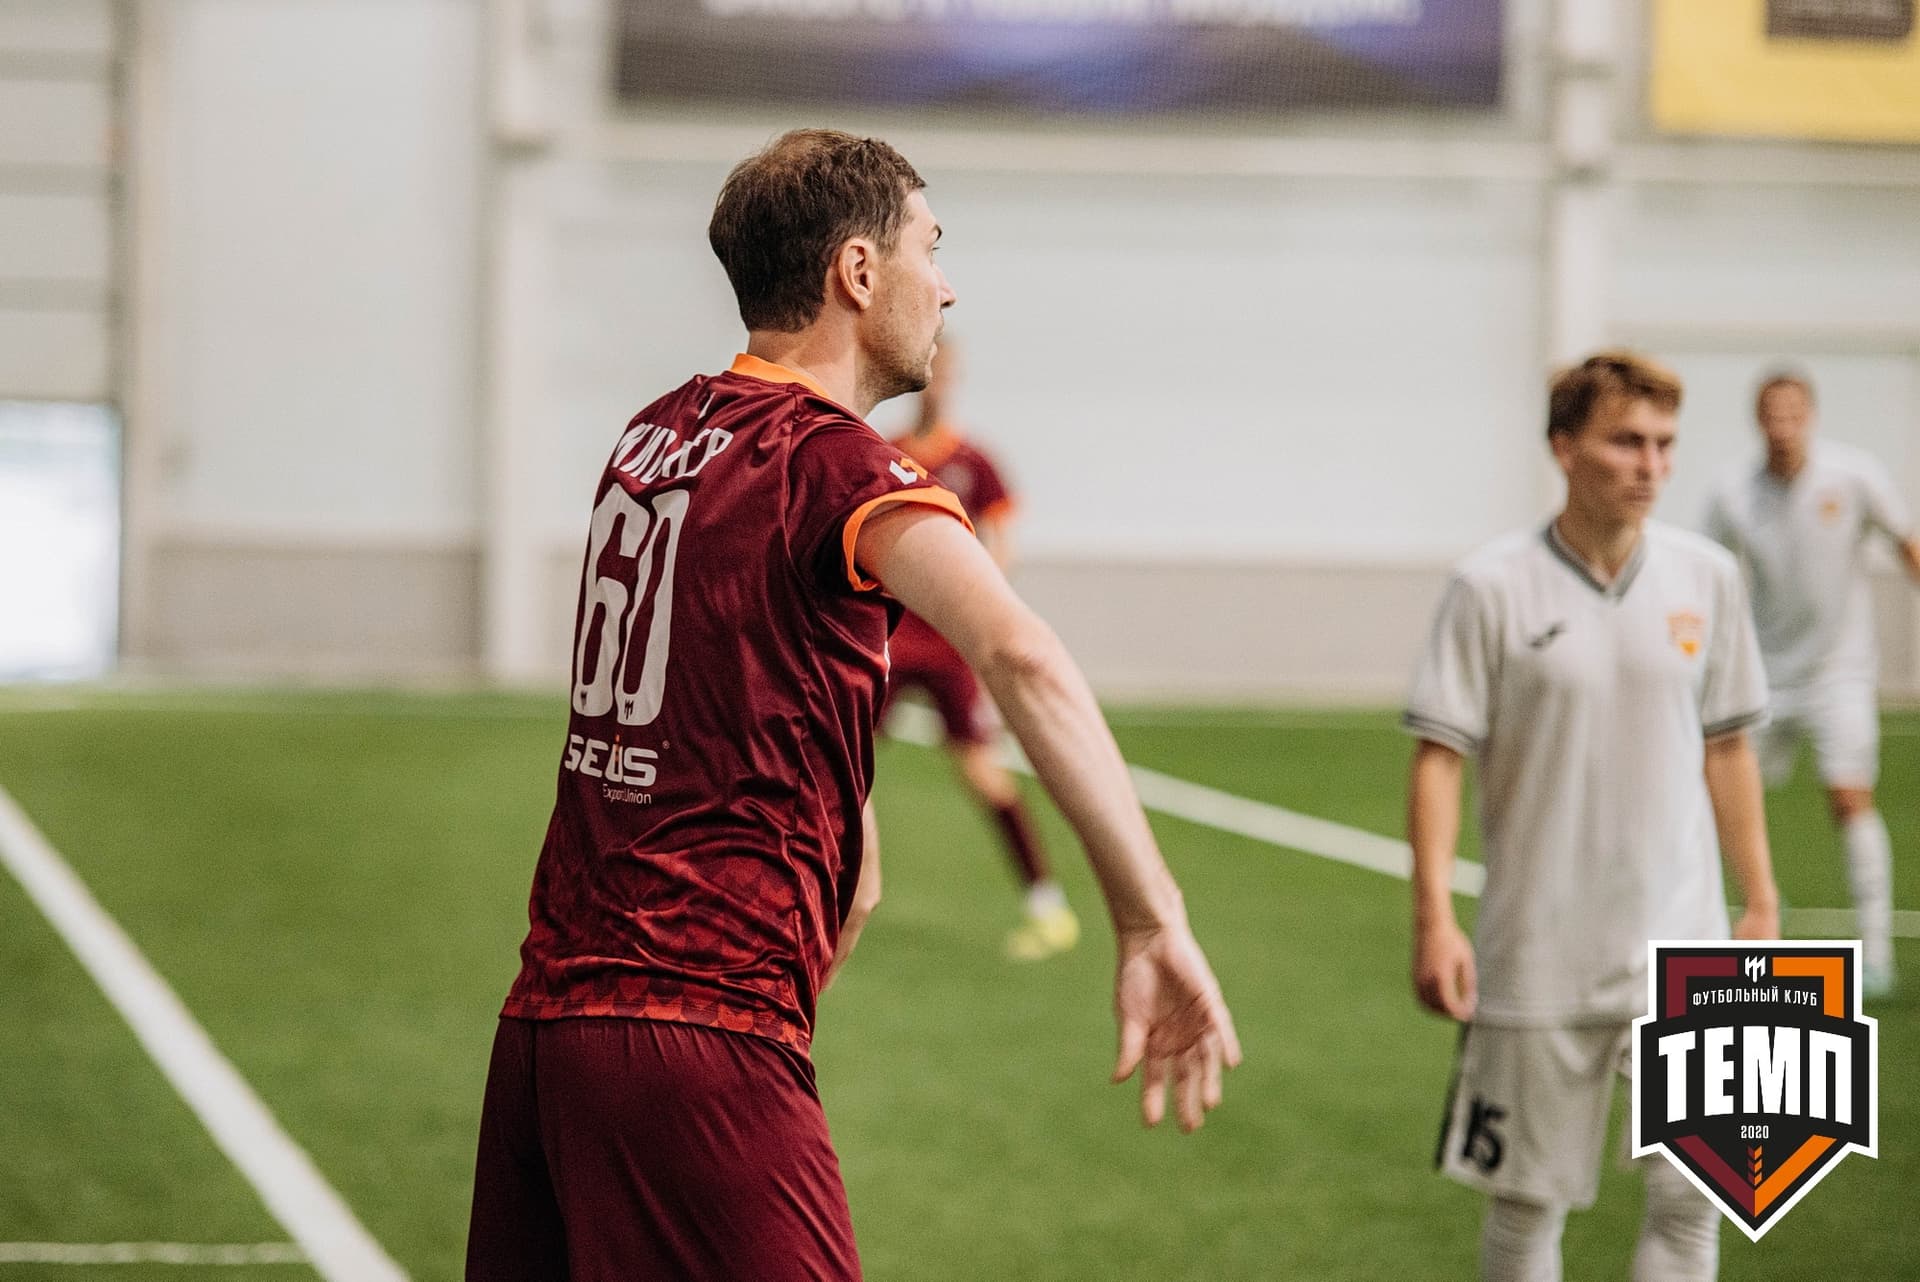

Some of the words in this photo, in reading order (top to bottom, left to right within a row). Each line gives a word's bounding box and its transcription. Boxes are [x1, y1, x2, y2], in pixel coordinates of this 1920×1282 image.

[572, 482, 690, 726] 60
[564, 733, 659, 787] SEUS
[1462, 1097, 1507, 1174] 15
